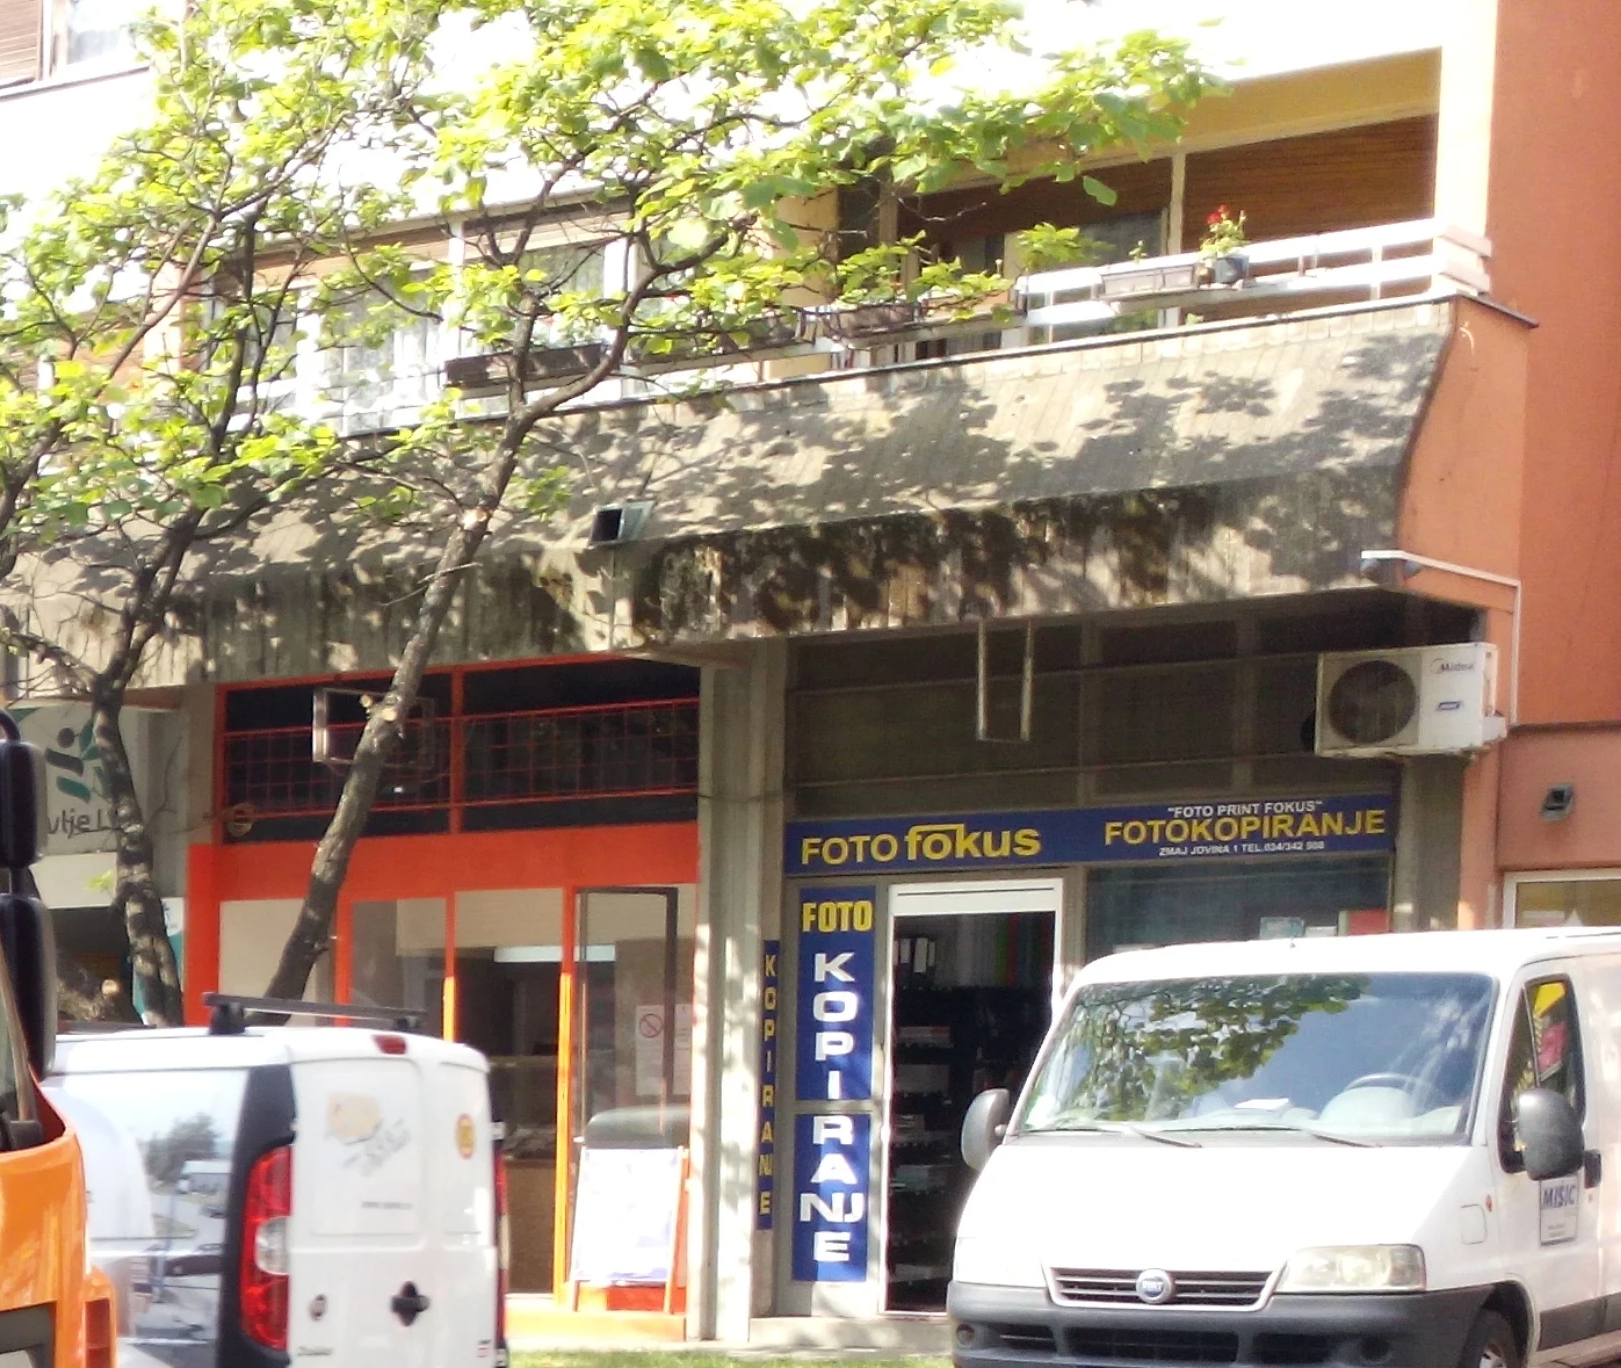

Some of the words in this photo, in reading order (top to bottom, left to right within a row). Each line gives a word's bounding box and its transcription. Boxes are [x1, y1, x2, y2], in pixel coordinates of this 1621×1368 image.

[1105, 809, 1386, 845] FOTOKOPIRANJE
[1217, 803, 1261, 816] PRINT
[801, 834, 899, 865] FOTO
[904, 823, 1042, 861] fokus
[802, 901, 873, 933] FOTO
[800, 952, 865, 1262] KOPIRANJE
